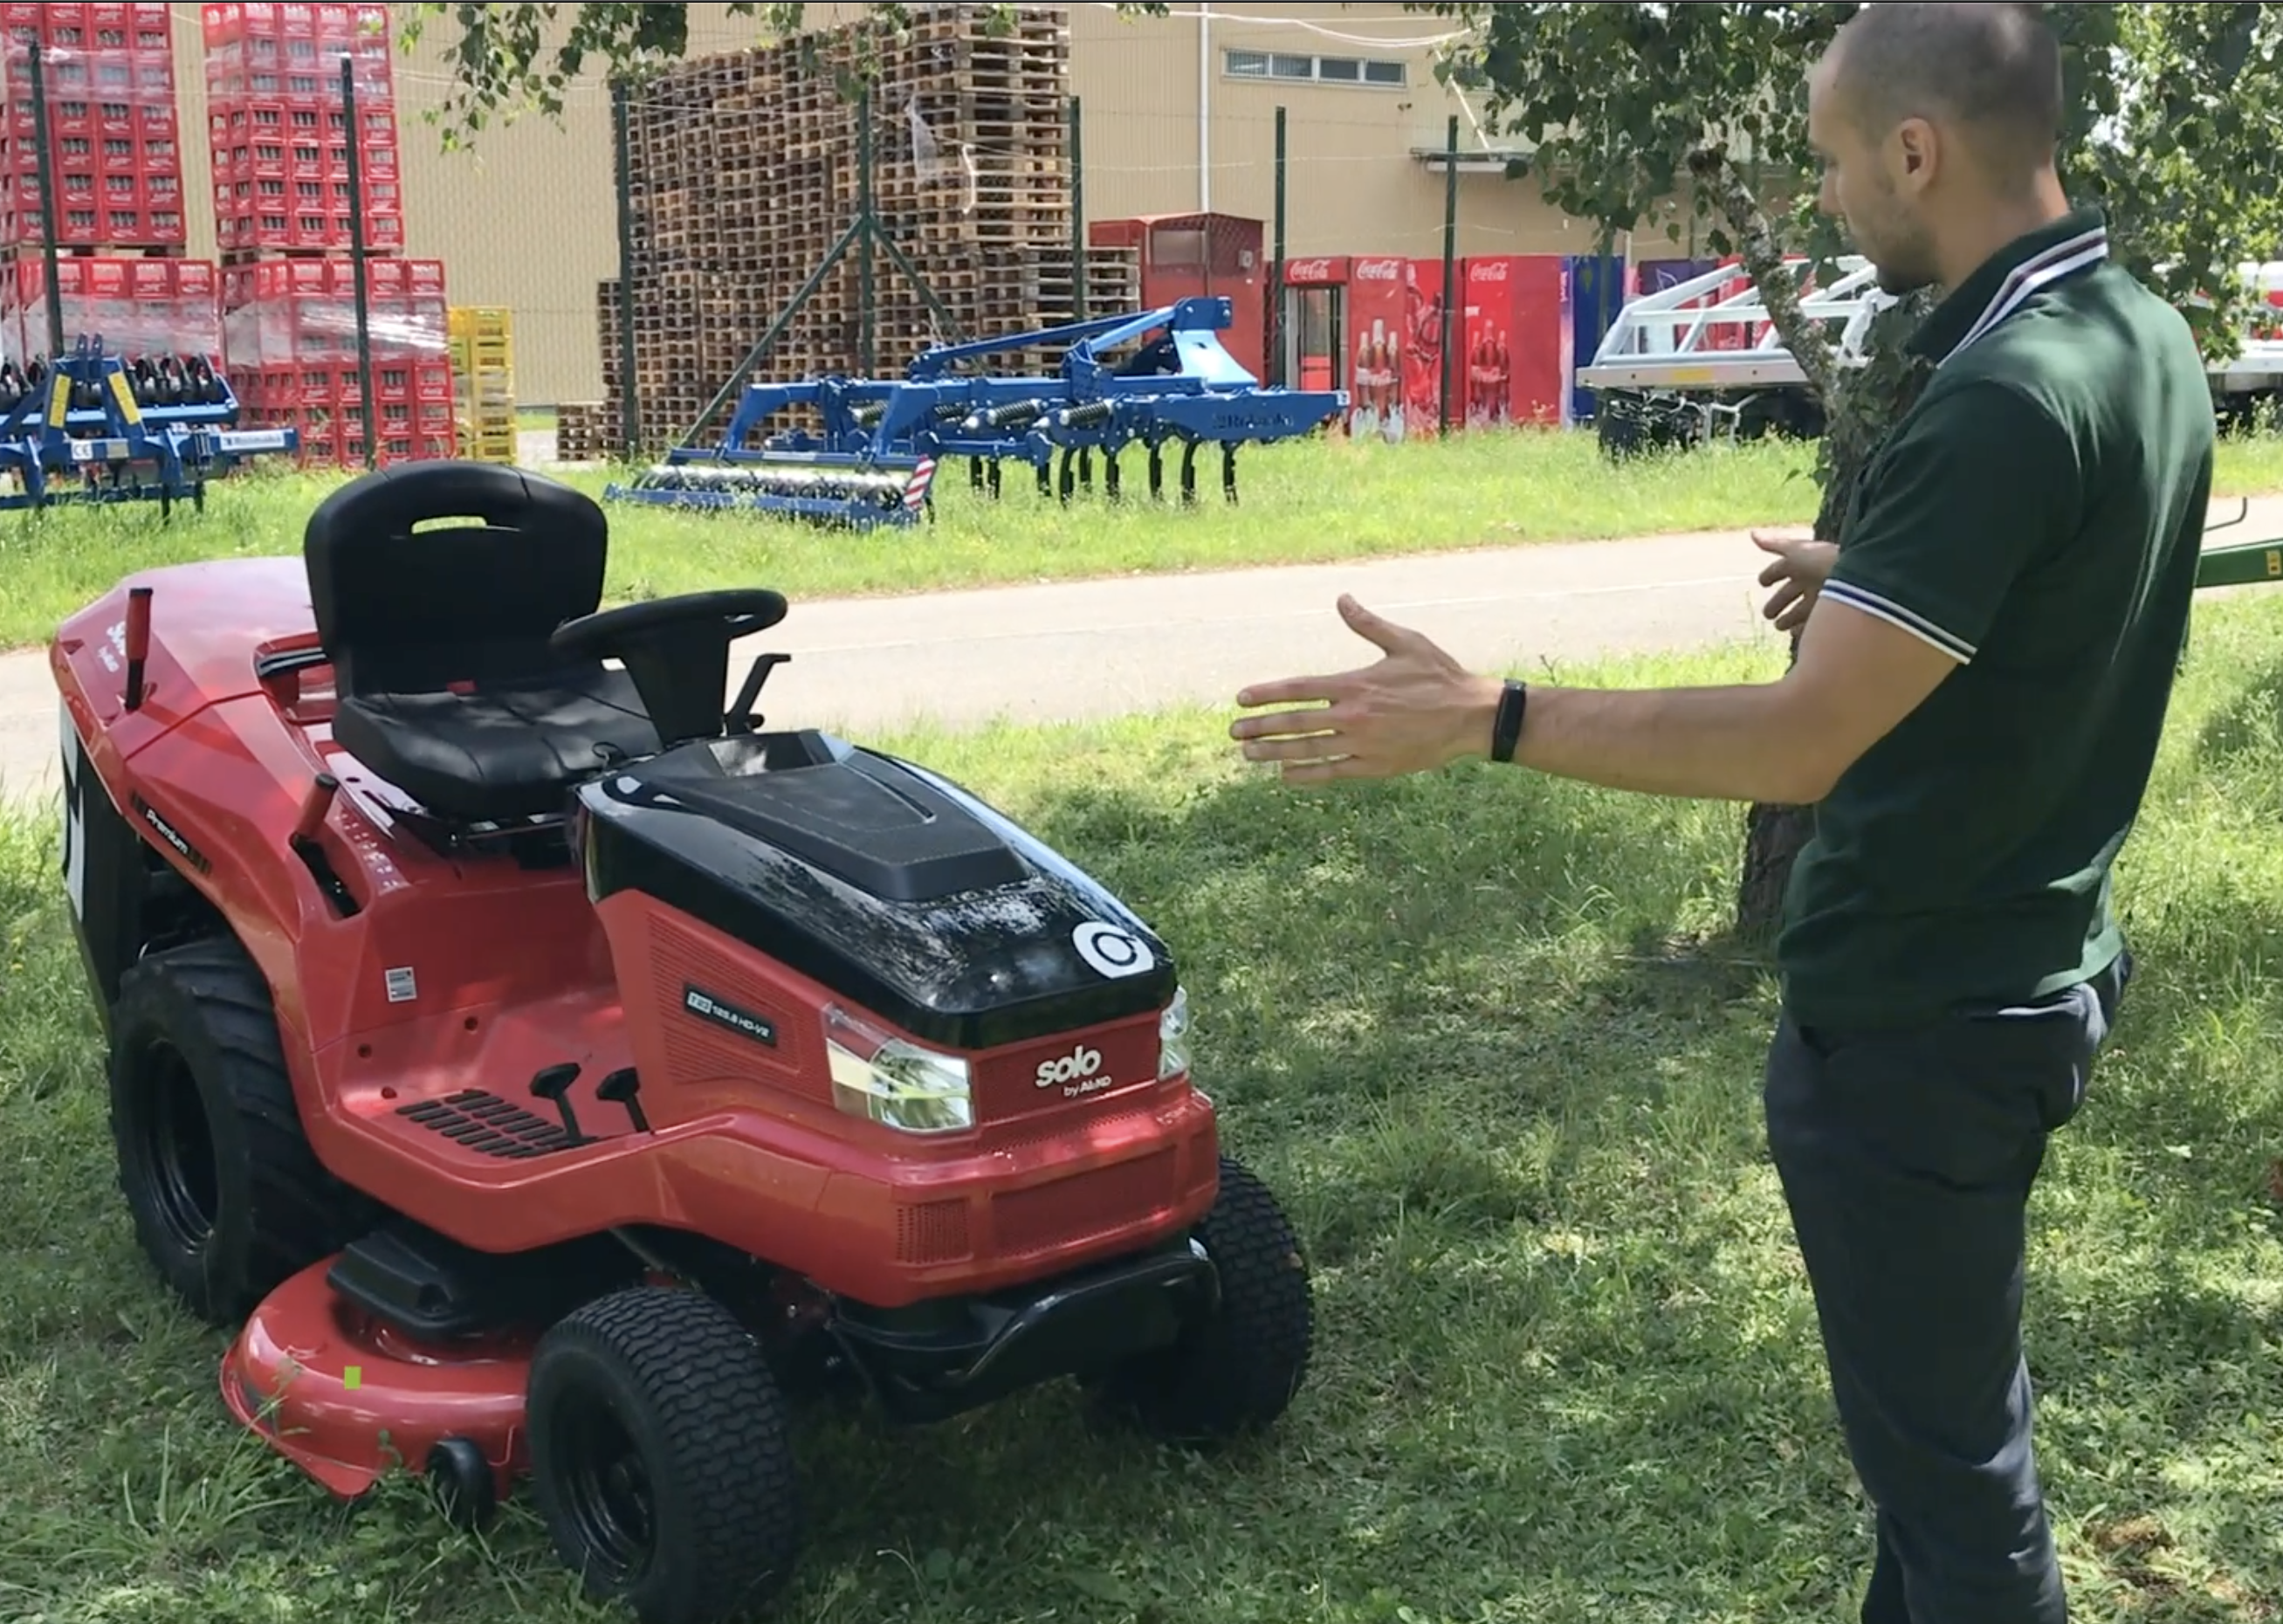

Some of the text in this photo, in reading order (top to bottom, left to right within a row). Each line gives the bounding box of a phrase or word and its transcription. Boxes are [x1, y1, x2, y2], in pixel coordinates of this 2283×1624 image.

[146, 809, 189, 854] Premium
[1035, 1044, 1101, 1087] solo
[1063, 1084, 1079, 1098] by
